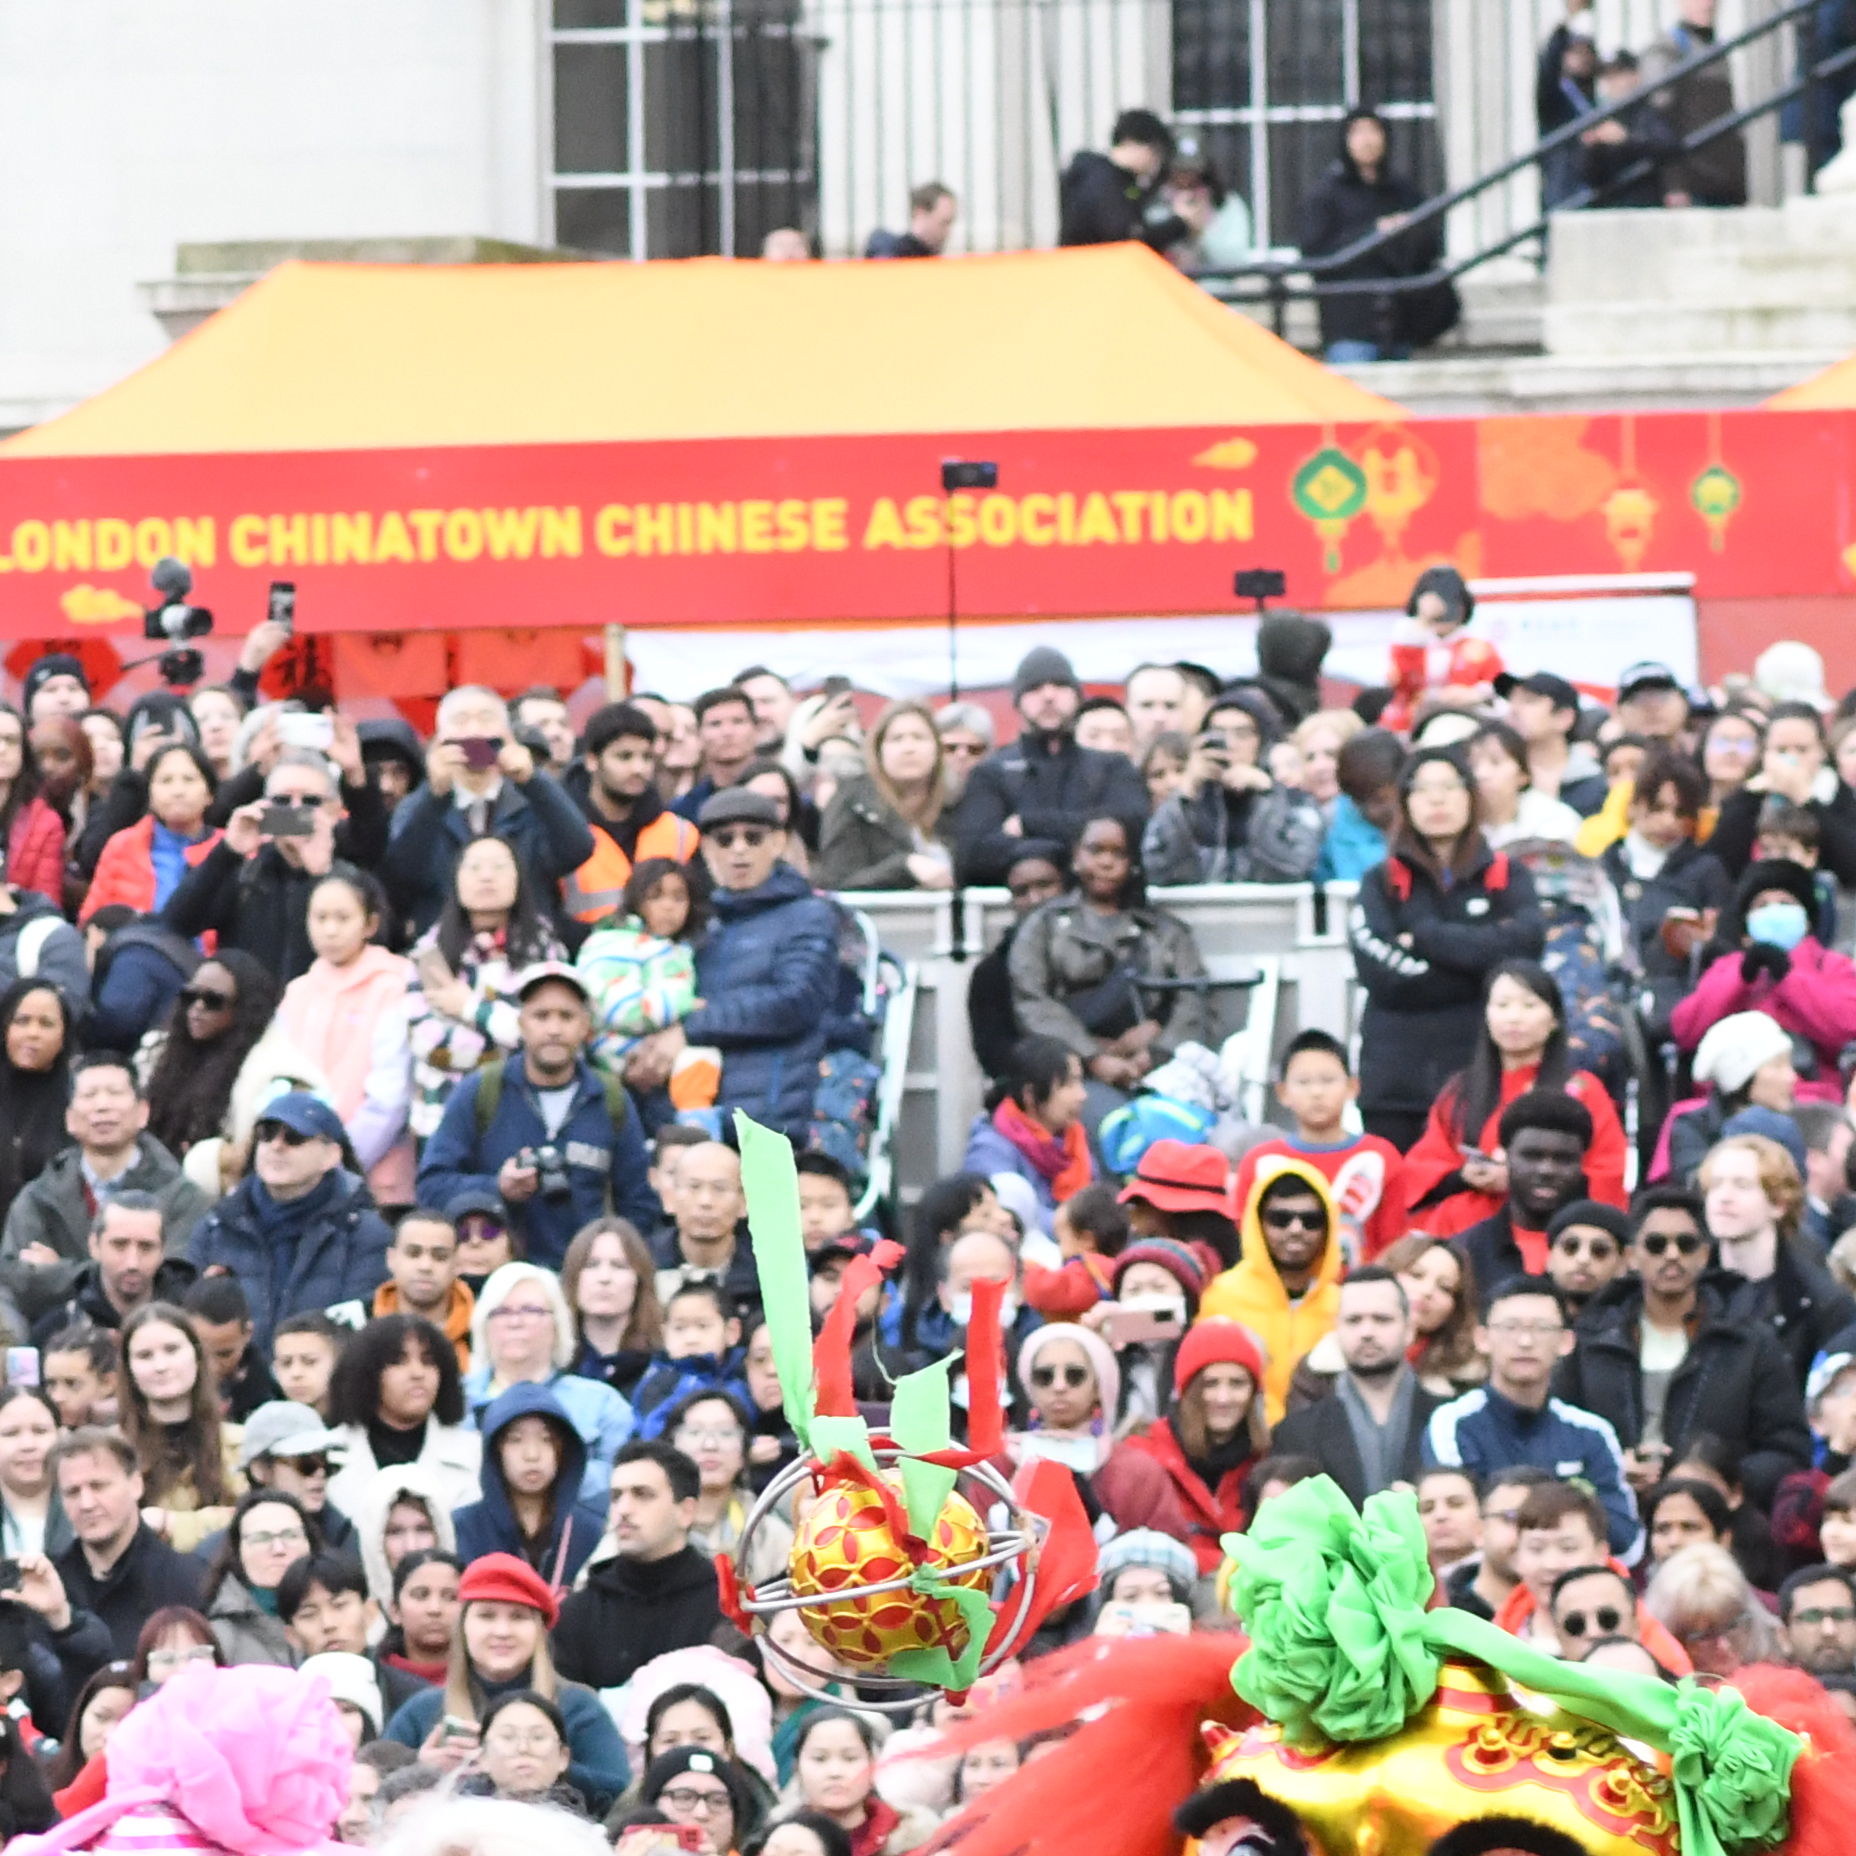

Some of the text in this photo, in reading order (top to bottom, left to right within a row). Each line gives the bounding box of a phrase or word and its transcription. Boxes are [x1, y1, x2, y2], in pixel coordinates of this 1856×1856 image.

[229, 505, 582, 568] CHINATOWN
[595, 498, 848, 557] CHINESE
[863, 488, 1253, 550] ASSOCIATION
